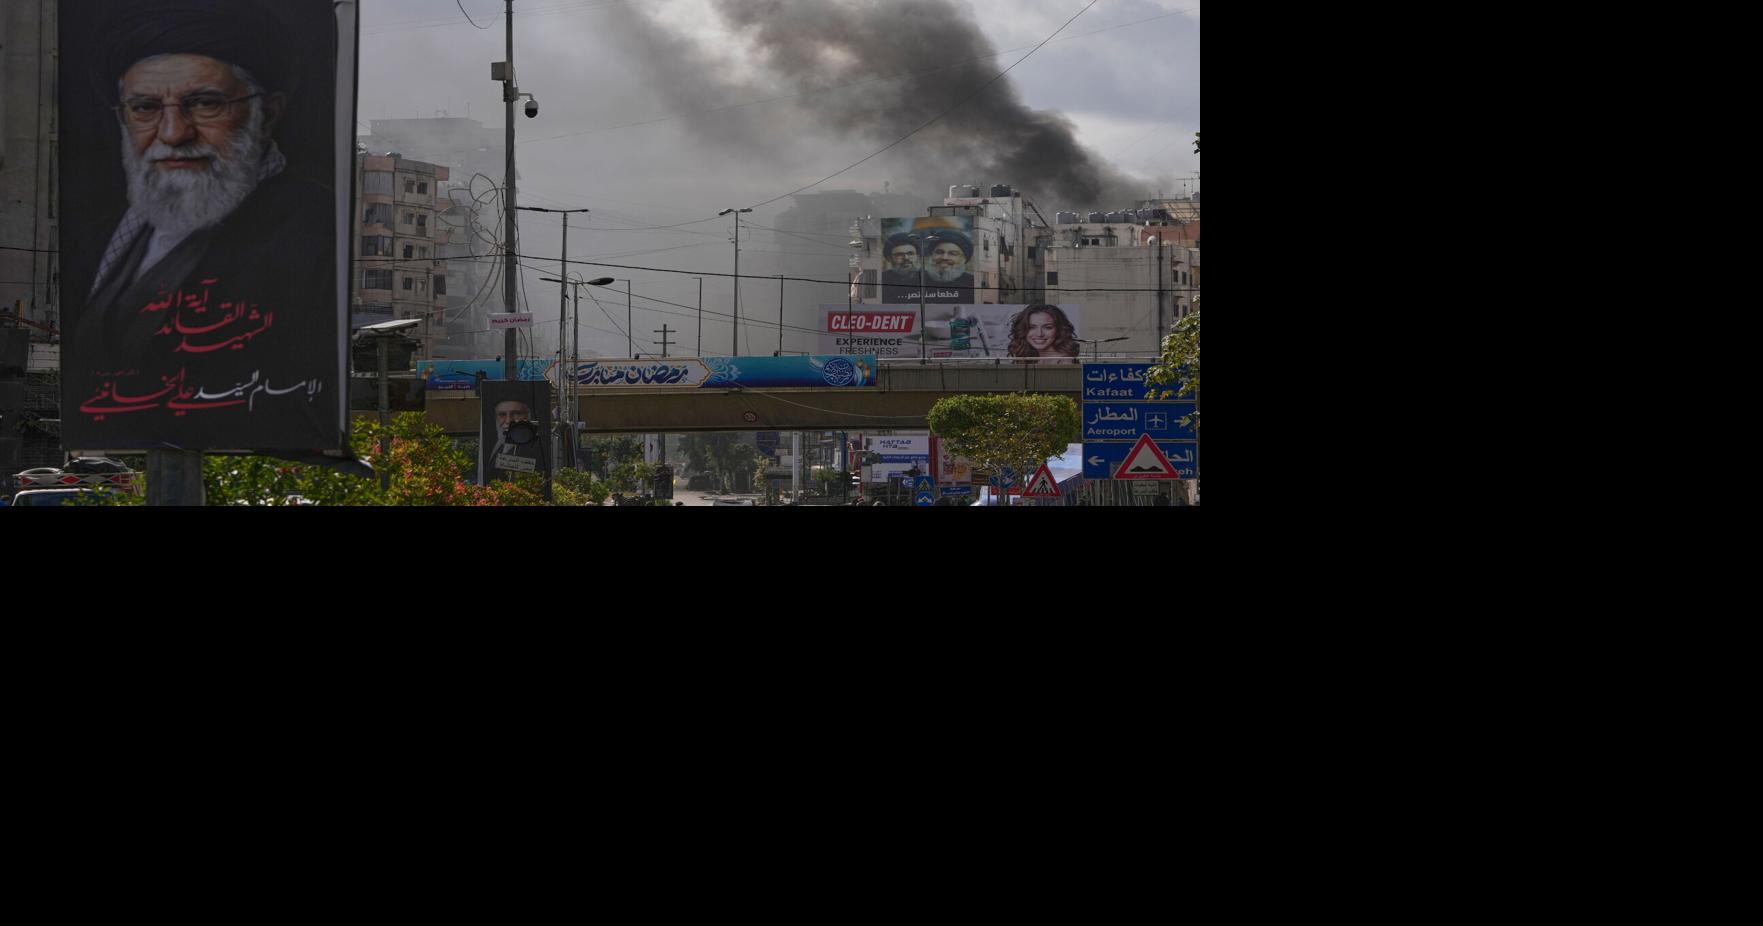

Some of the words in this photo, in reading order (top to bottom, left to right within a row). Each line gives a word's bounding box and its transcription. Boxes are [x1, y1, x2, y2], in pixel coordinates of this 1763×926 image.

[139, 283, 182, 313] الله
[154, 301, 246, 335] القائد
[831, 314, 909, 330] CLEO-DENT
[836, 337, 903, 346] EXPERIENCE
[839, 347, 899, 355] FRESHNESS
[1086, 367, 1144, 383] كفاءات
[1086, 387, 1133, 397] Kafaat
[1087, 406, 1138, 424] المطار
[1087, 427, 1136, 436] Aeroport
